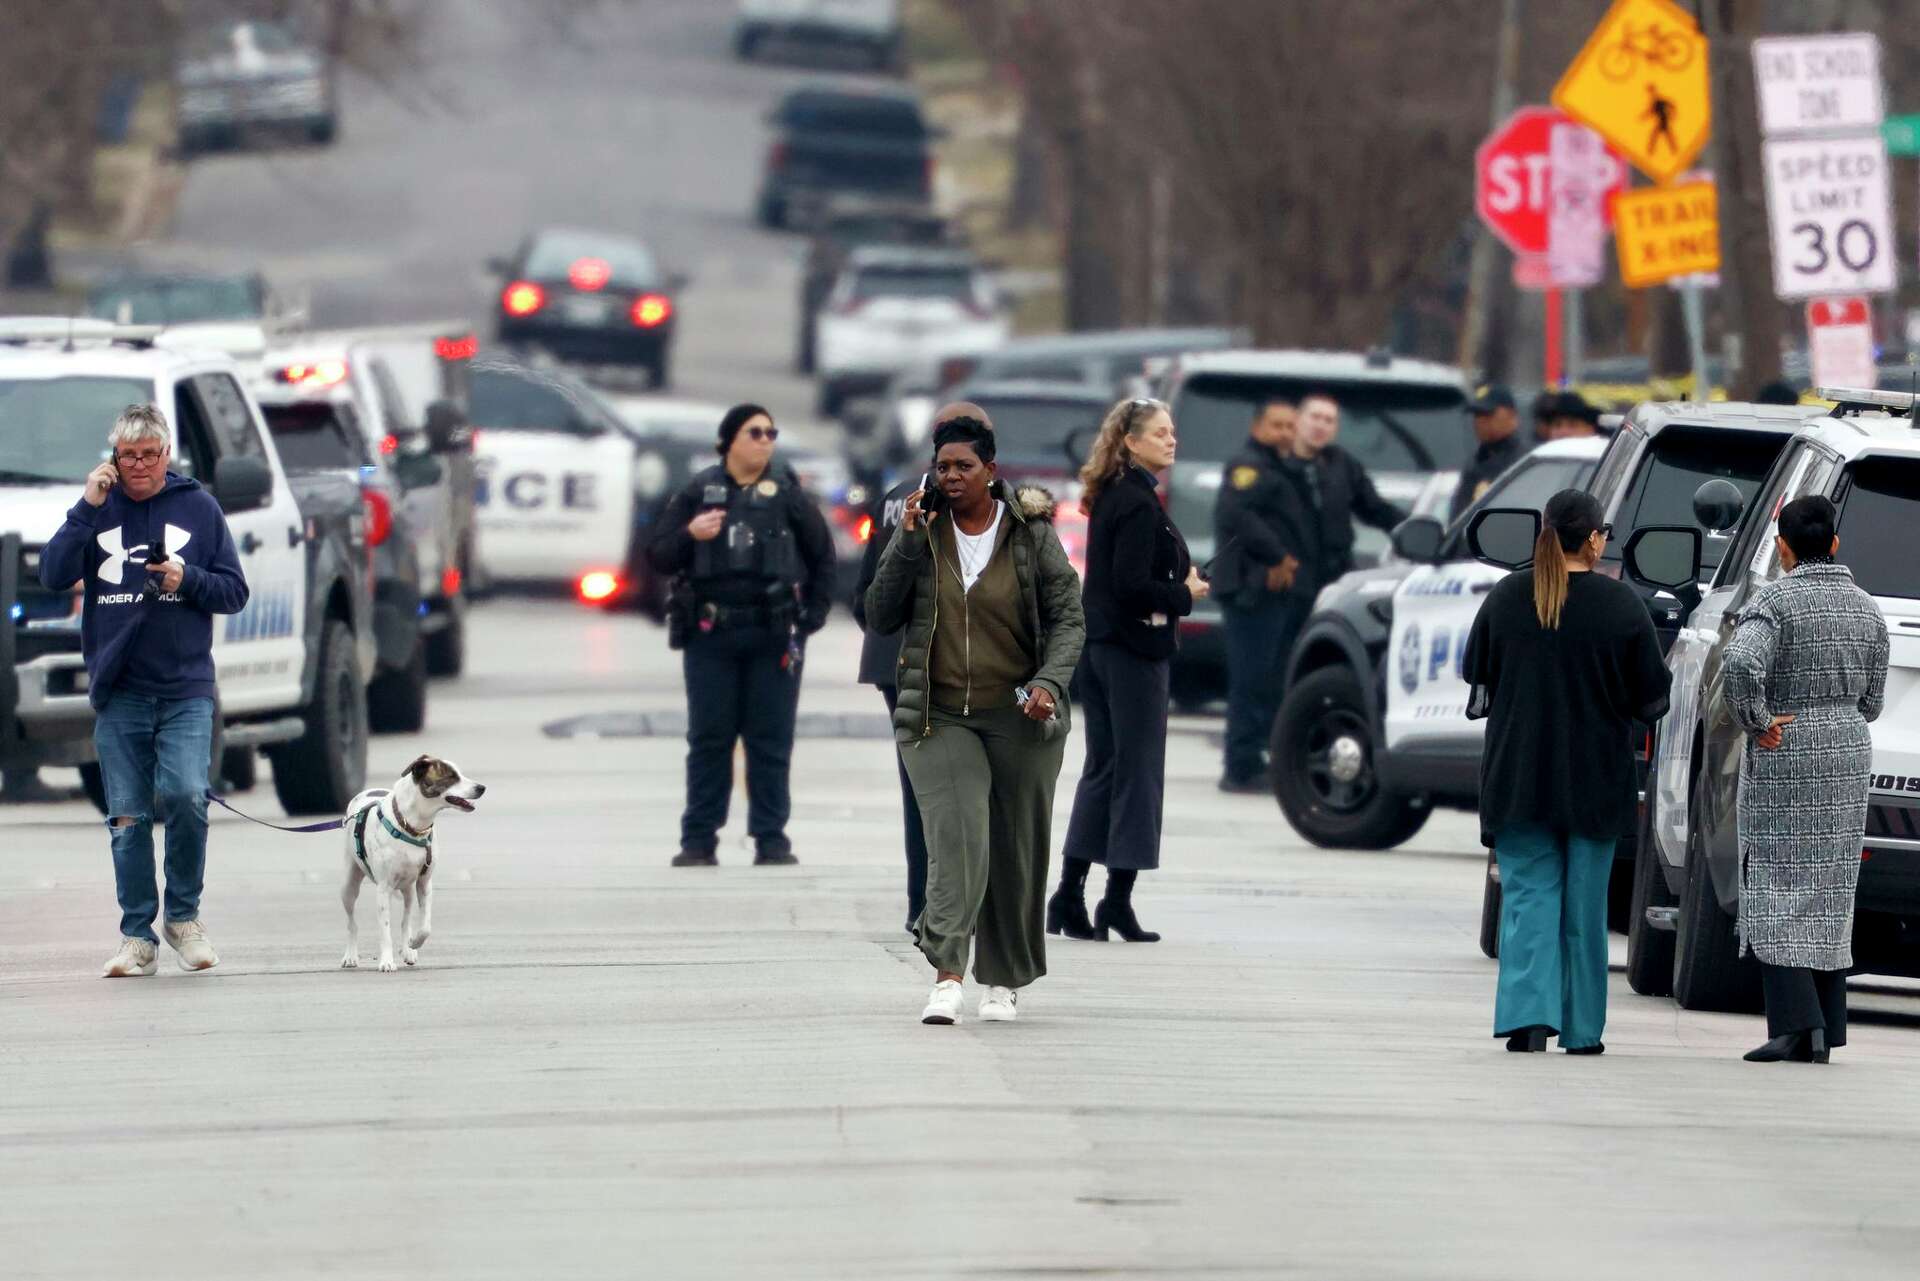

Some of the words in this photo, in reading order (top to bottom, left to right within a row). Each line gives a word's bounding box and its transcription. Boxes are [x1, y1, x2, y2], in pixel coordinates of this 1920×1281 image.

[1780, 153, 1876, 181] SPEED
[1790, 185, 1864, 212] LIMIT
[1791, 219, 1878, 274] 30
